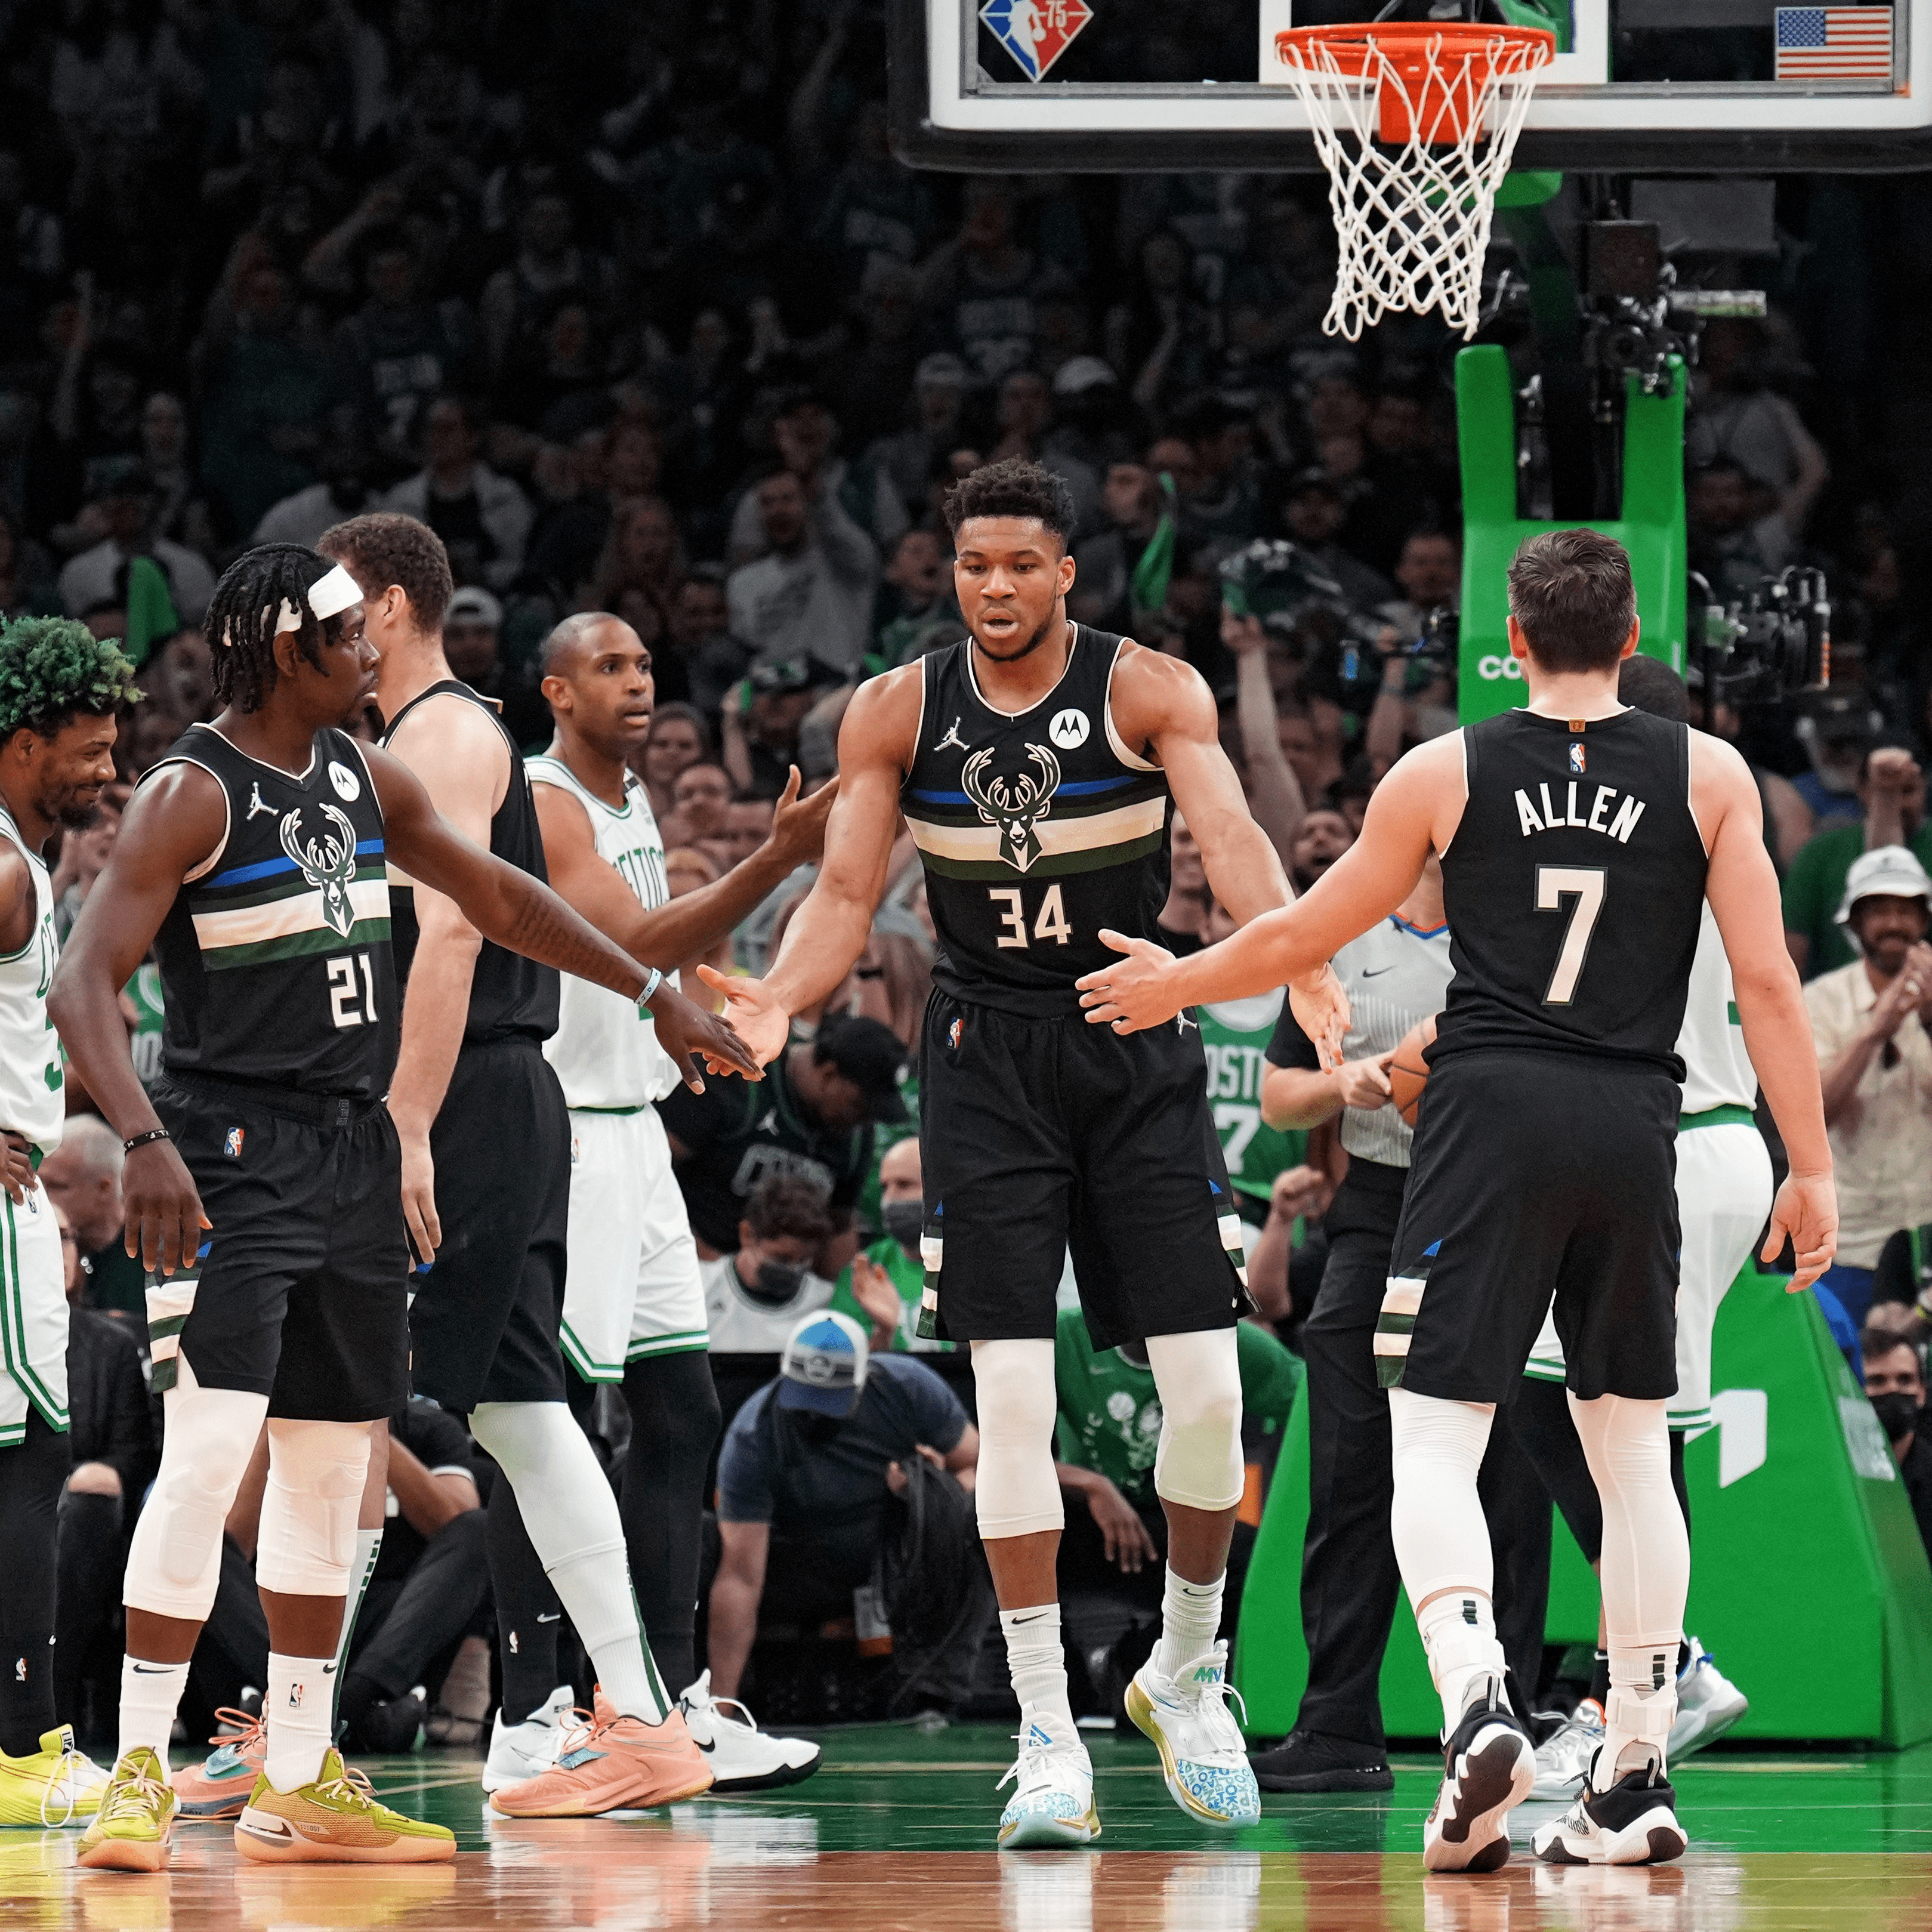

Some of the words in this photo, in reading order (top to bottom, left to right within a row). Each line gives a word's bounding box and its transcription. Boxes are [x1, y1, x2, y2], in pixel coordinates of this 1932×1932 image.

[1045, 0, 1067, 27] 75
[1514, 781, 1646, 844] ALLEN
[988, 884, 1072, 949] 34
[1536, 866, 1606, 1005] 7
[326, 953, 378, 1028] 21
[1214, 1103, 1261, 1174] 7
